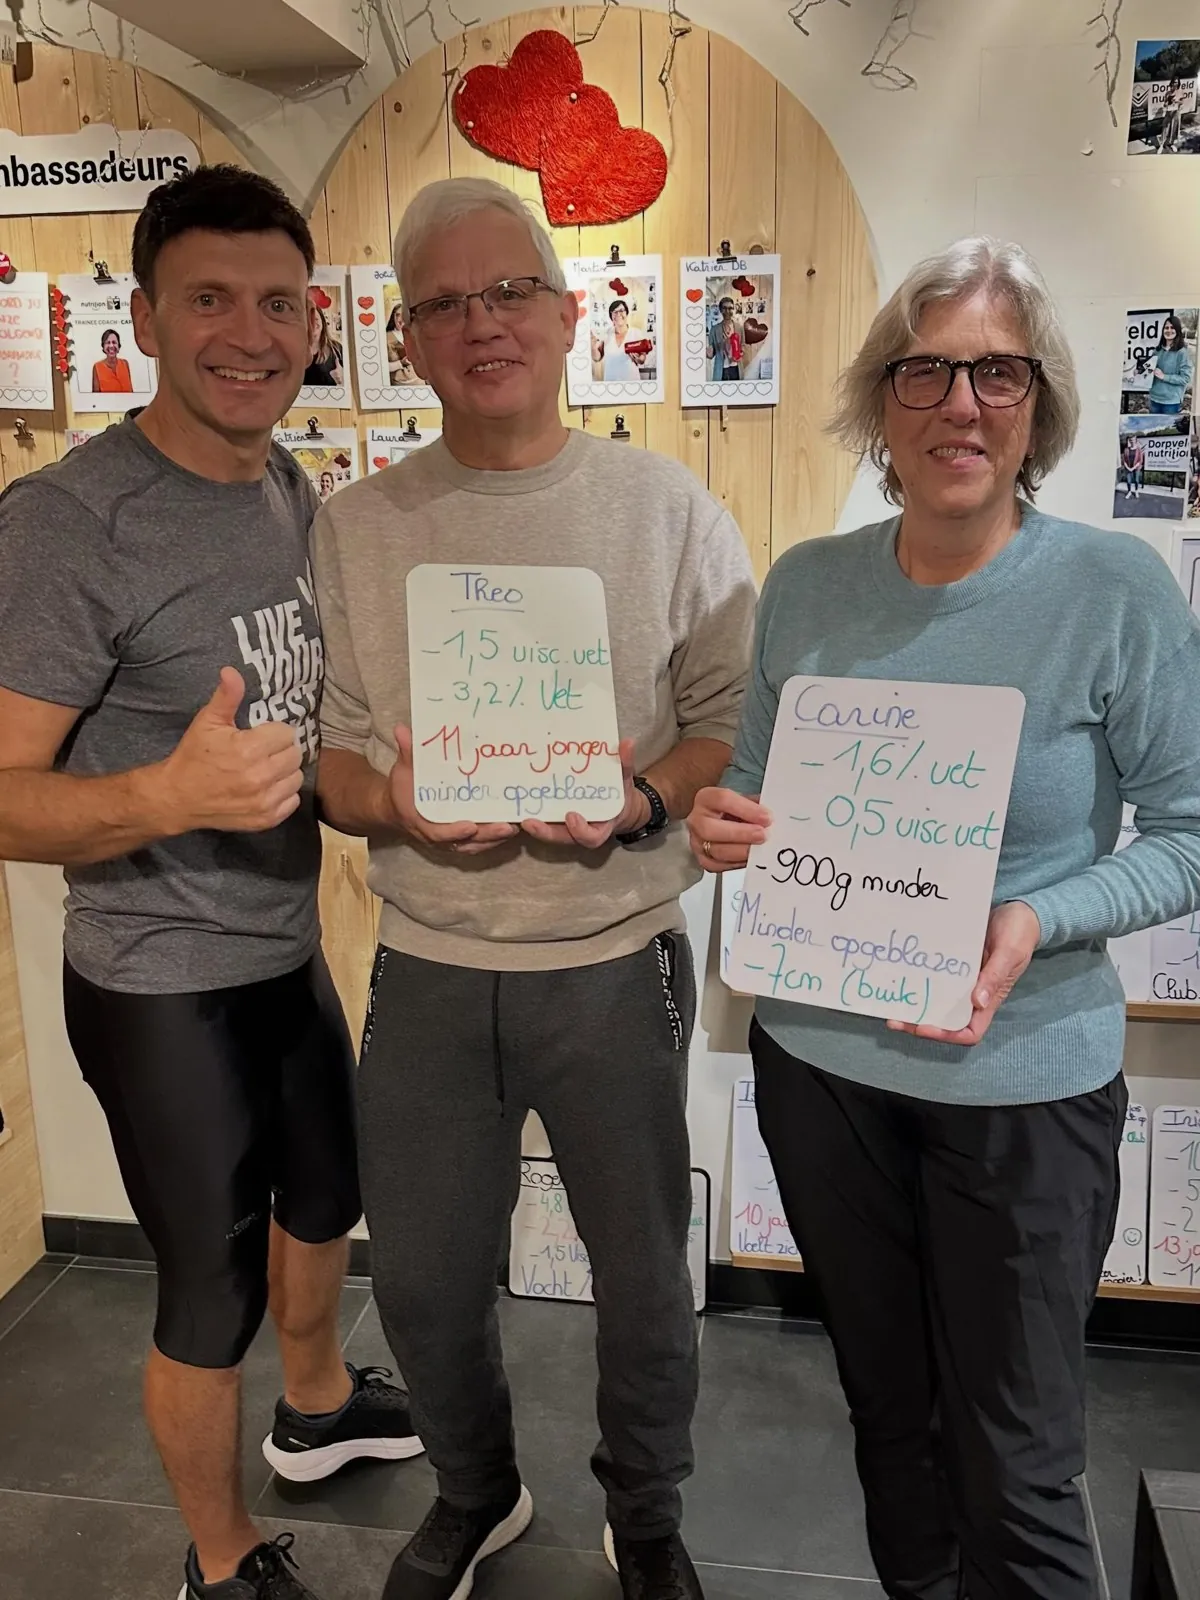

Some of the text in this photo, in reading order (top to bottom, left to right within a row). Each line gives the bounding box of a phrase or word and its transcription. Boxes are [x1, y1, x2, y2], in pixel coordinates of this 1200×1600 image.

[1127, 320, 1159, 340] eld
[1147, 448, 1189, 460] nutritio
[1148, 438, 1189, 450] Dorpvel
[230, 599, 305, 665] LIVE
[794, 684, 920, 729] Carine
[418, 773, 621, 816] minder opgeblazen
[737, 892, 971, 979] Minder opgeblazen
